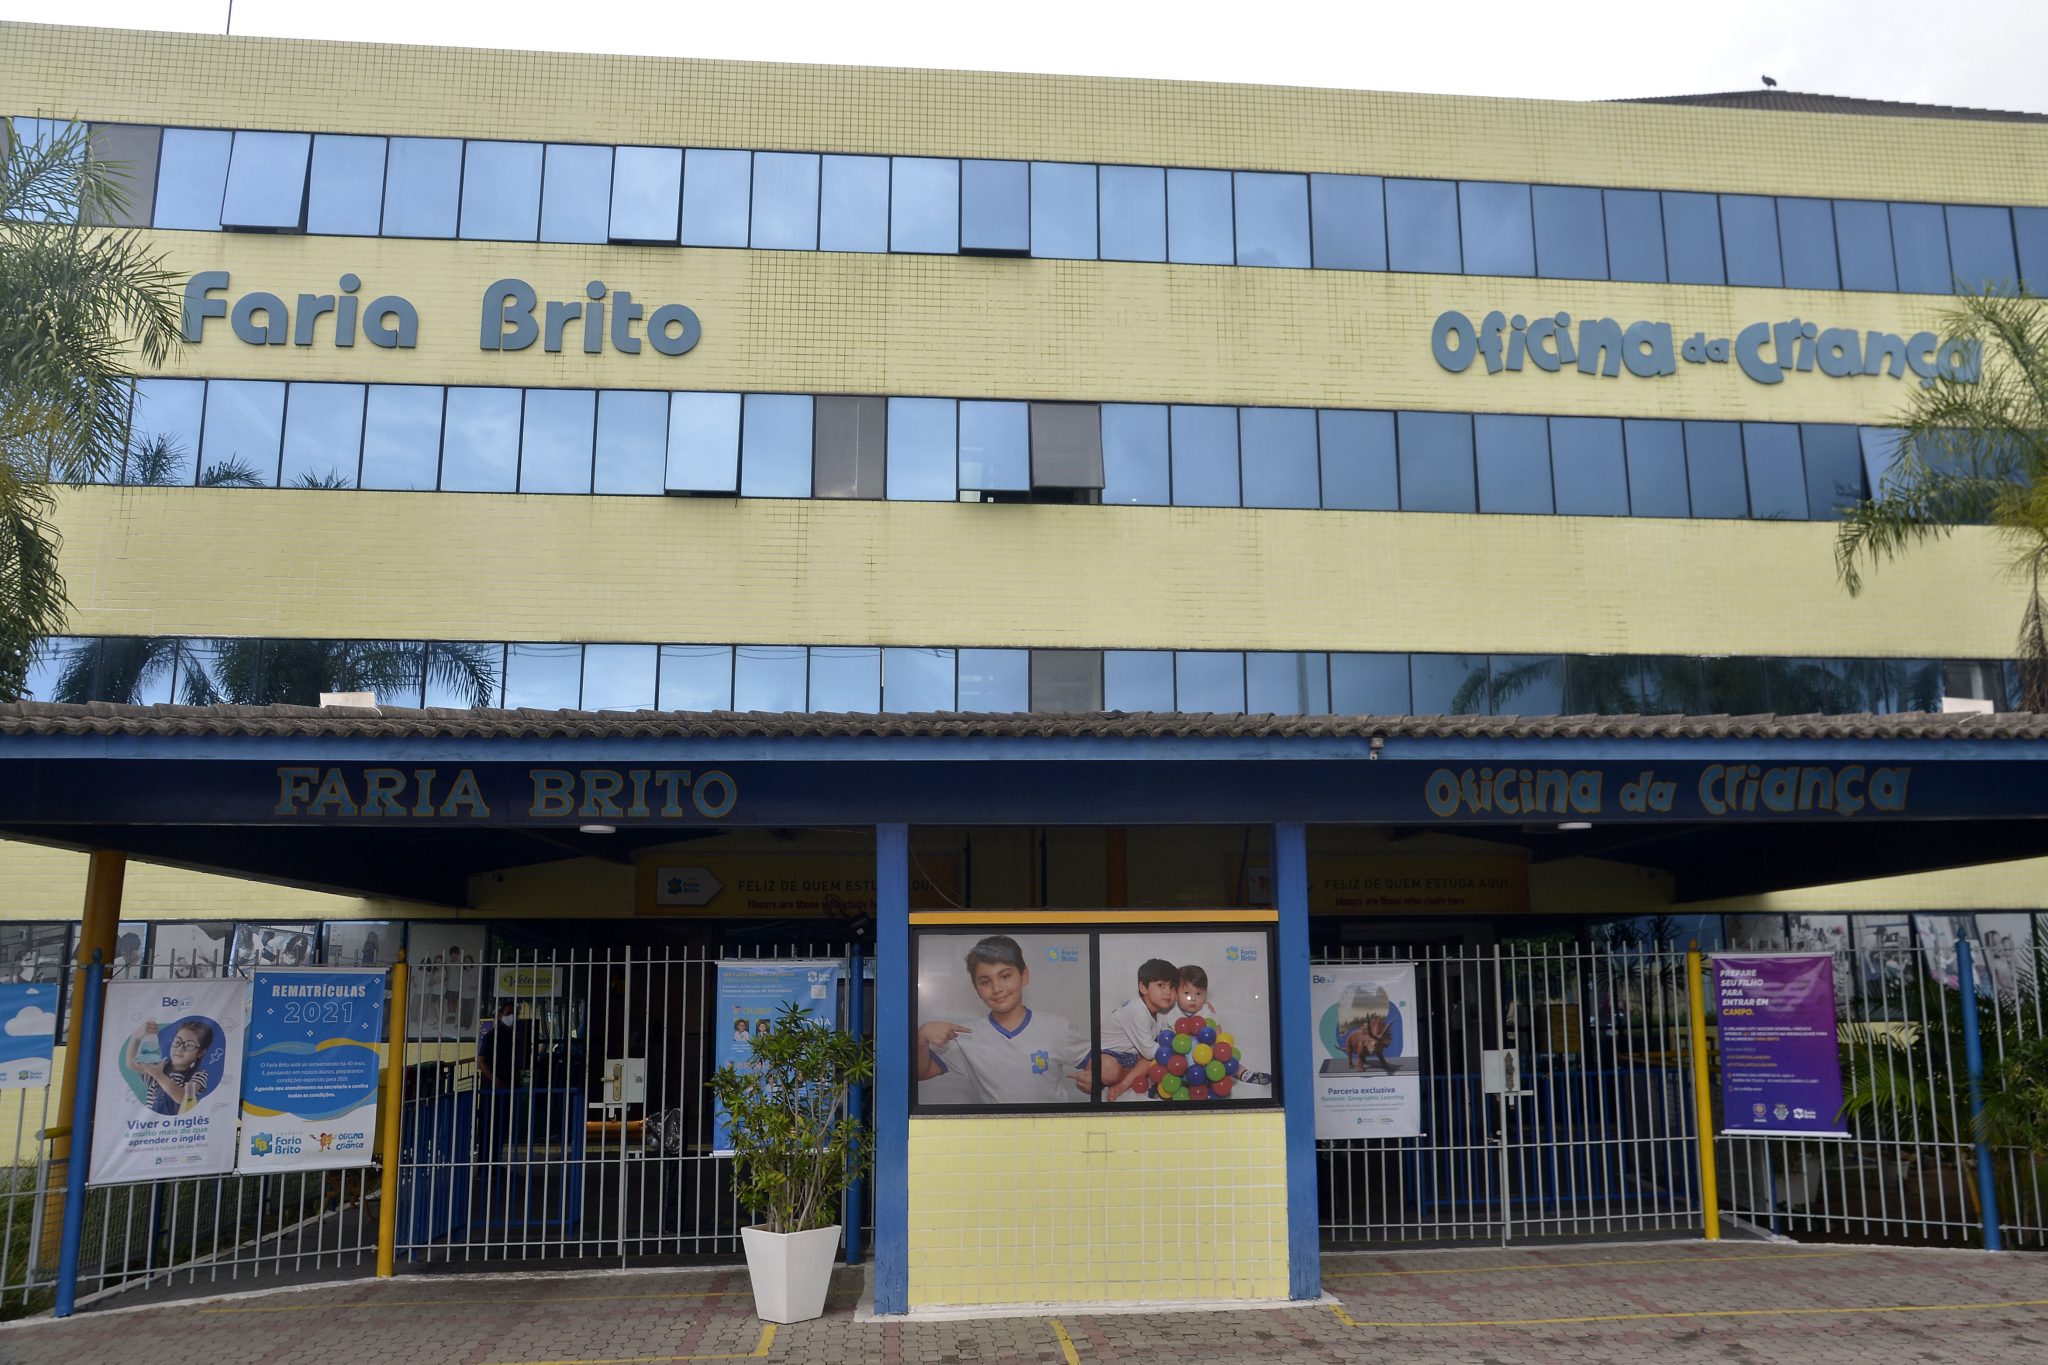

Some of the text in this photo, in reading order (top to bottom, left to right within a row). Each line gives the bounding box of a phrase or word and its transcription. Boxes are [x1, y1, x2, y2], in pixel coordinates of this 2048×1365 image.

[182, 271, 701, 355] Faria Brito
[1432, 310, 1676, 378] Oficina
[1681, 332, 1730, 363] da
[274, 767, 737, 818] FARIA BRITO
[1425, 764, 1912, 817] Oficina da Criança
[738, 880, 776, 892] FELIZ
[781, 880, 798, 891] DE
[802, 880, 841, 892] QUEM
[846, 880, 877, 891] ESTU
[1325, 879, 1360, 890] FELIZ
[1365, 879, 1381, 889] DE
[1385, 879, 1421, 889] QUEM
[1426, 878, 1474, 889] ESTUDA
[1720, 969, 1757, 977] PREPARE
[503, 975, 551, 987] Welcme
[1312, 975, 1326, 984] Be
[272, 983, 366, 998] REMATRÍCULAS
[162, 996, 179, 1007] Be
[1722, 998, 1769, 1006] ENTRAR EM
[283, 1002, 353, 1024] 2021
[127, 1116, 209, 1129] Viver o inglês
[128, 1137, 170, 1147] aprender
[179, 1134, 206, 1143] inglês
[275, 1136, 302, 1145] Faria
[275, 1146, 301, 1155] Brito
